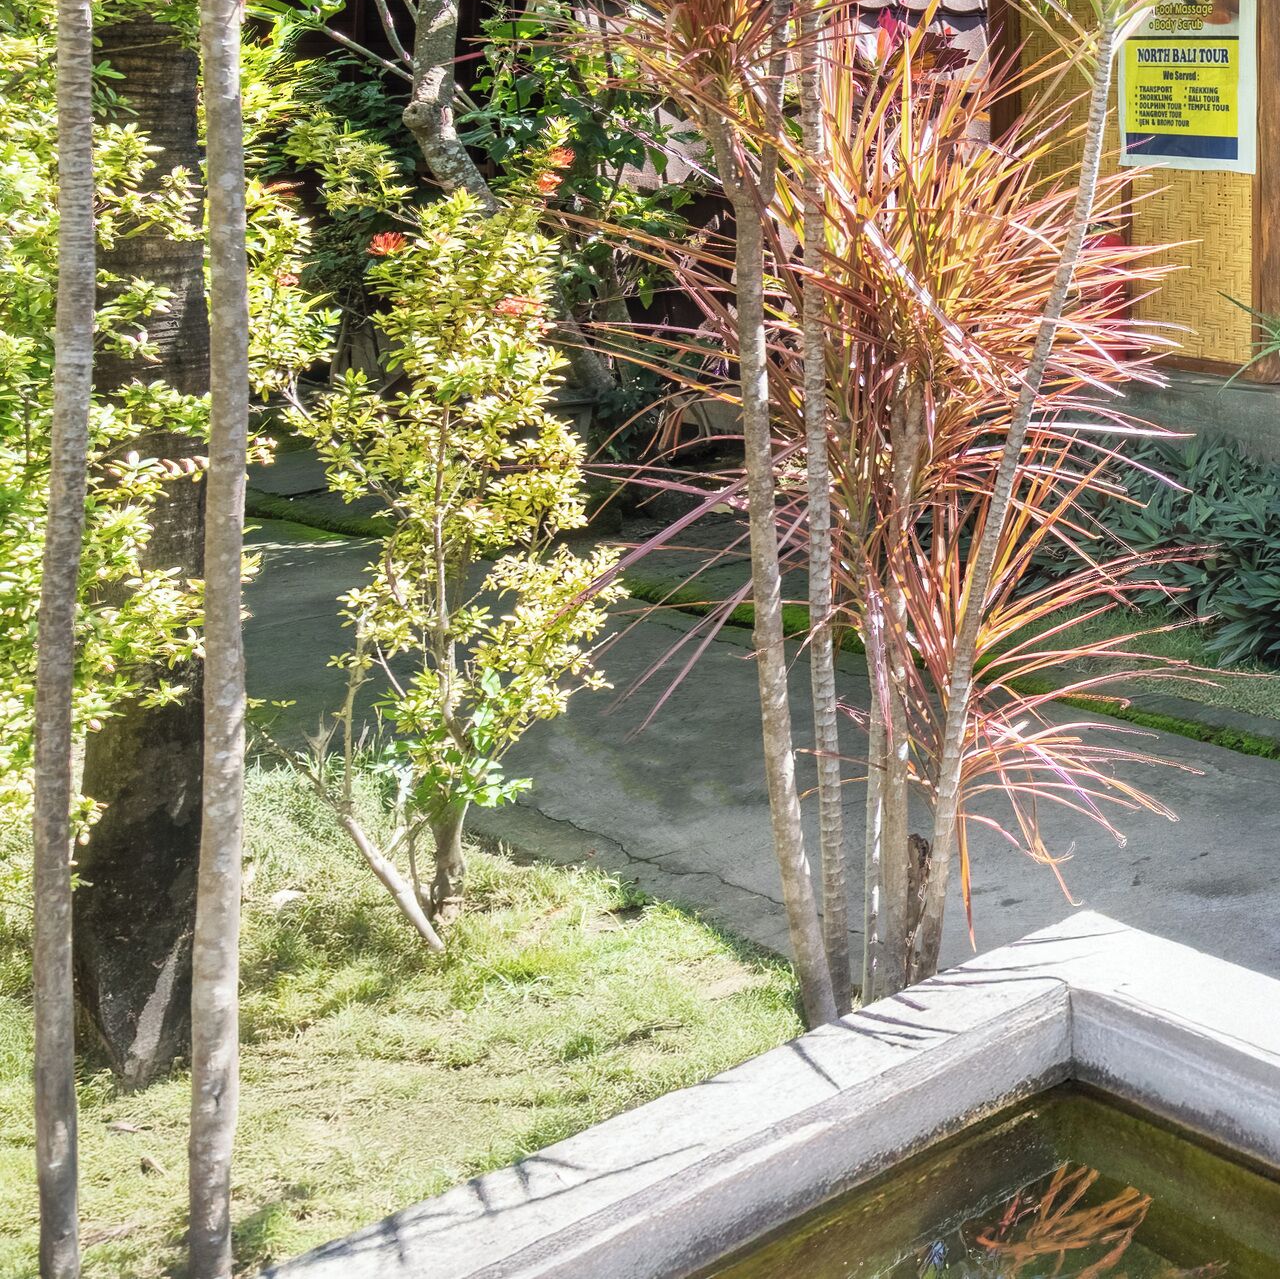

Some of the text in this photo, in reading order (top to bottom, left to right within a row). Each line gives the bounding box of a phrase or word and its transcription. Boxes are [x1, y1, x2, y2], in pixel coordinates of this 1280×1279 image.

[1155, 3, 1213, 17] Foot Massage
[1155, 17, 1203, 33] Body Scrub
[1137, 48, 1229, 63] NORTH BALI TOUR
[1163, 71, 1174, 80] We
[1188, 86, 1218, 94] TREKKING
[1139, 94, 1173, 102] SNORKLING
[1203, 95, 1220, 103] TOUR
[1139, 102, 1166, 110] DOLPHIN
[1188, 103, 1230, 112] TEMPLE TOUR
[1139, 110, 1182, 119] MANGROVE TOUR
